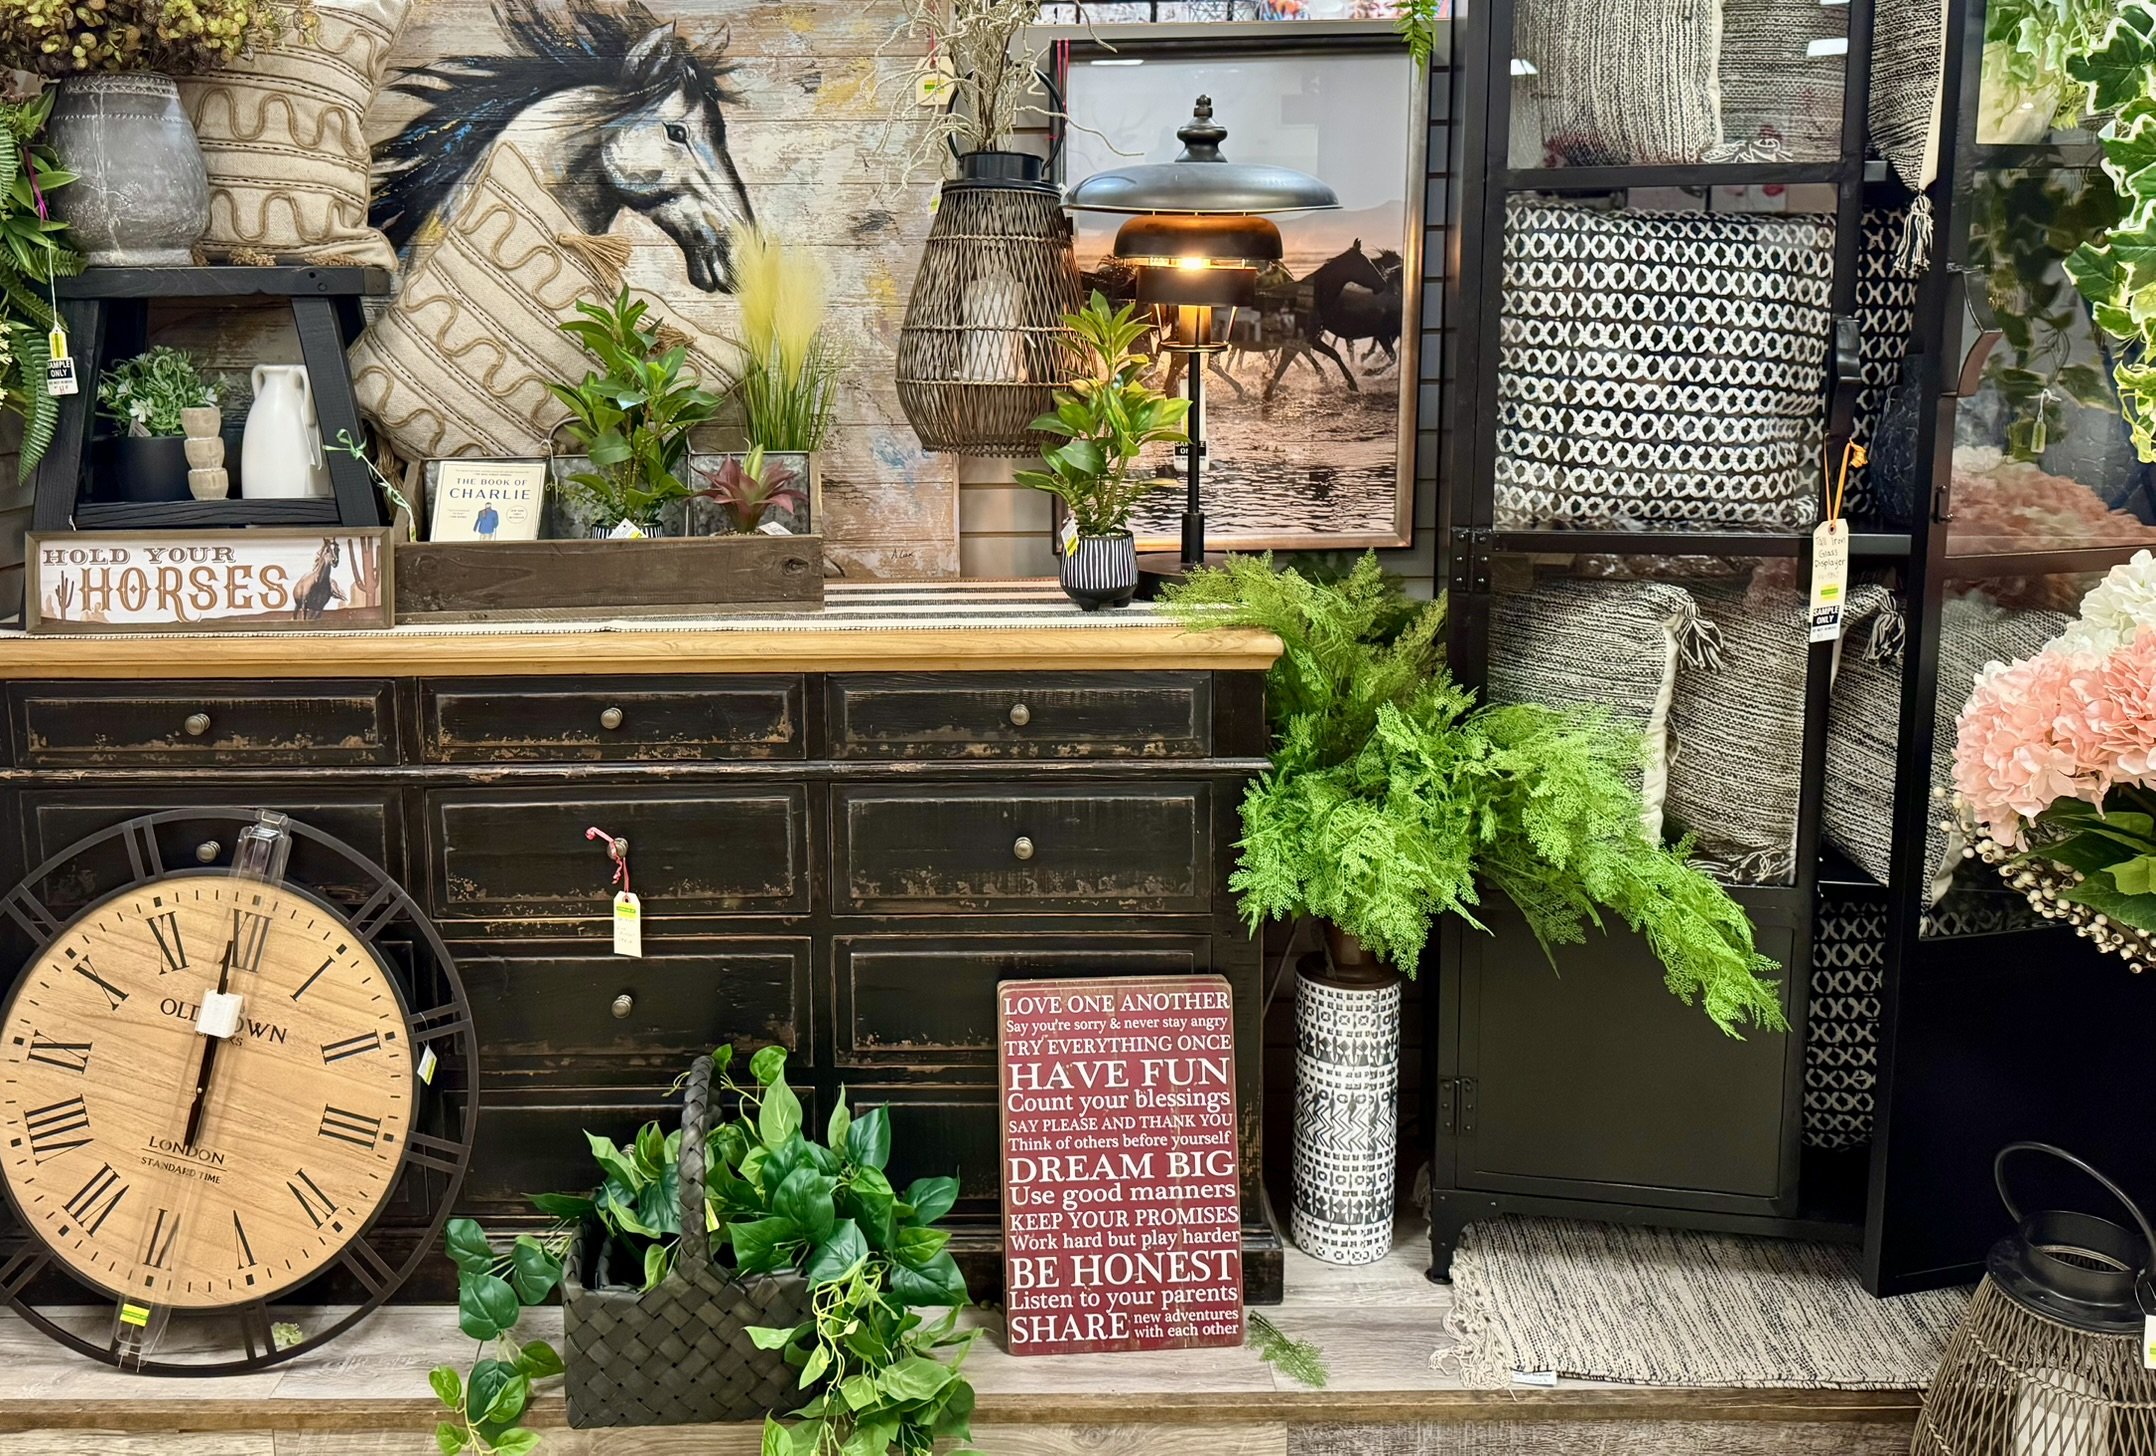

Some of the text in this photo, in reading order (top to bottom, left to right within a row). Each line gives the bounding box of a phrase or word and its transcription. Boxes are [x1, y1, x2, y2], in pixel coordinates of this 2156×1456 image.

[50, 369, 68, 377] ONLY
[449, 488, 531, 500] CHARLIE
[43, 546, 237, 567] HOLD YOUR
[80, 564, 289, 623] HORSES
[1816, 615, 1835, 624] ONLY
[1004, 991, 1230, 1016] LOVE ONE ANOTHER
[1006, 1017, 1228, 1036] Say you're sorry & never stay angry
[1005, 1035, 1231, 1056] TRY EVERYTHING ONCE
[1008, 1057, 1230, 1091] HAVE FUN
[1008, 1089, 1230, 1117] Count your blessings
[1009, 1113, 1233, 1133] SAY PLEASE AND THANK YOU
[148, 1136, 225, 1165] LONDON
[1008, 1131, 1231, 1151] Think of others before yourself
[141, 1156, 222, 1184] STANDARD TIME
[1008, 1150, 1236, 1184] DREAM BIG
[1009, 1183, 1236, 1210] Use good manners
[1009, 1206, 1239, 1231] KEEP YOUR PROMISES
[1010, 1228, 1240, 1251] Work hard but play harder
[1010, 1250, 1237, 1290] BE HONEST
[1009, 1285, 1238, 1313] Listen to your parents
[1011, 1312, 1130, 1344] SHARE
[1134, 1309, 1239, 1324] new adventures
[1134, 1323, 1239, 1338] with each other
